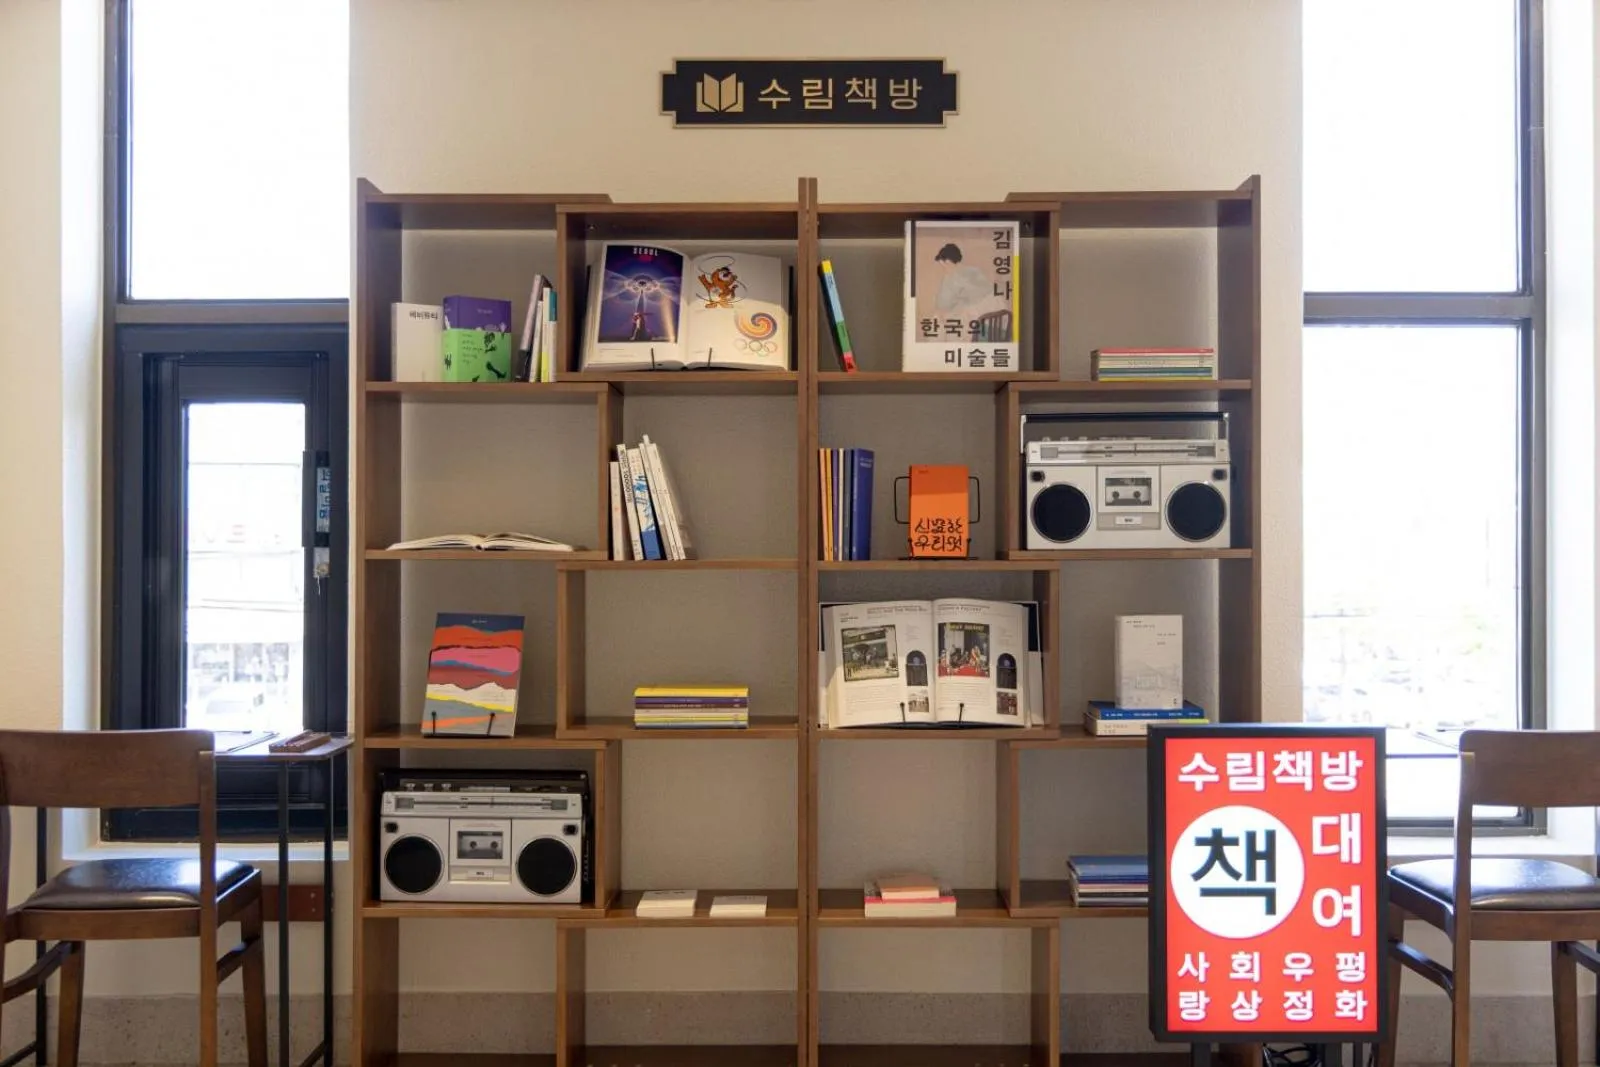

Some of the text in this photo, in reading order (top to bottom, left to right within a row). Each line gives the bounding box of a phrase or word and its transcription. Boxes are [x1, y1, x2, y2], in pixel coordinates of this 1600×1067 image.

[757, 77, 923, 110] 수림책방
[993, 230, 1013, 300] 김영나
[920, 318, 986, 338] 한국의
[945, 348, 1011, 368] 미술들
[1178, 751, 1363, 792] 수림책방
[1190, 828, 1277, 916] 책
[1312, 813, 1362, 937] 대여
[1177, 952, 1210, 1021] 사랑
[1230, 952, 1262, 1021] 회상
[1283, 952, 1314, 1021] 우정
[1335, 952, 1368, 1021] 평화
